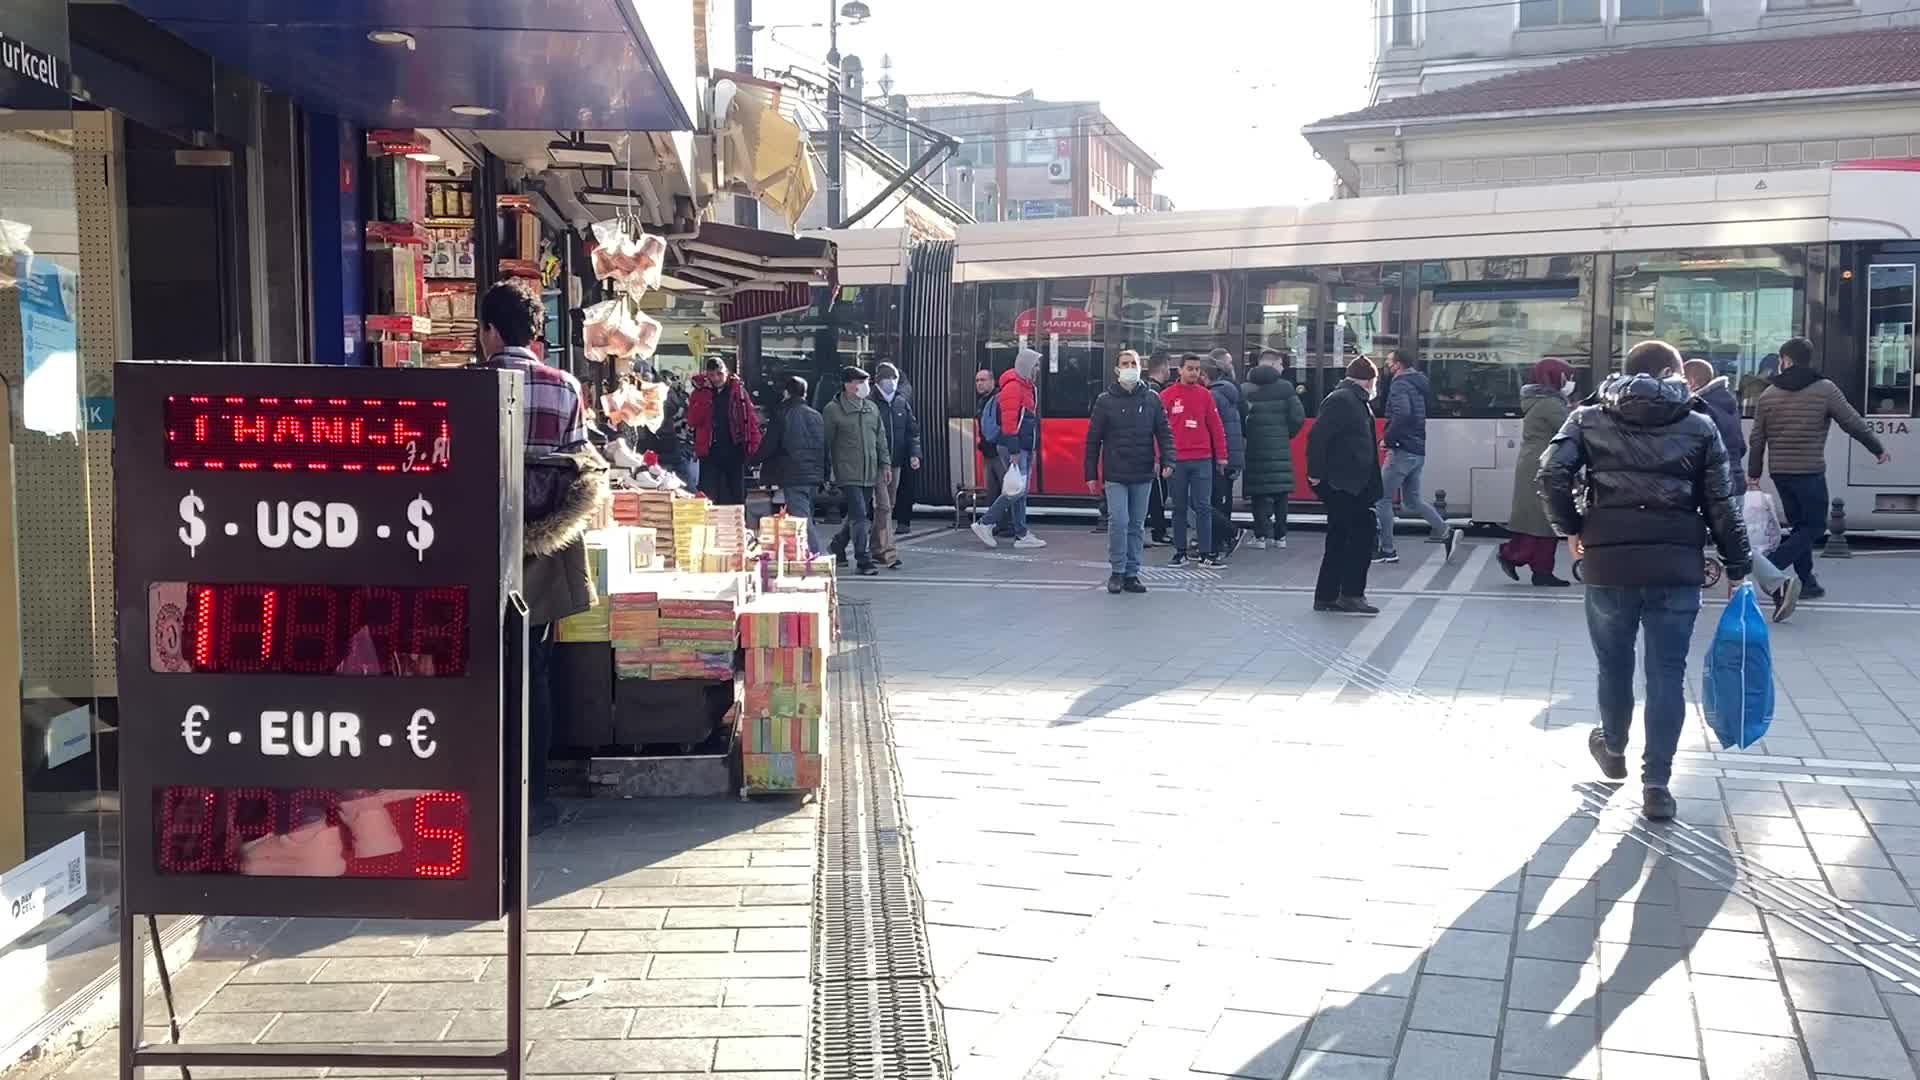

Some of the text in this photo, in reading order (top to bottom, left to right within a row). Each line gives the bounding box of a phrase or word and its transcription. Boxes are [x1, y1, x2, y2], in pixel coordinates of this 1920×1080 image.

[0, 32, 59, 88] urkcell
[178, 489, 435, 562] $ USD $
[182, 705, 437, 759] € EUR €
